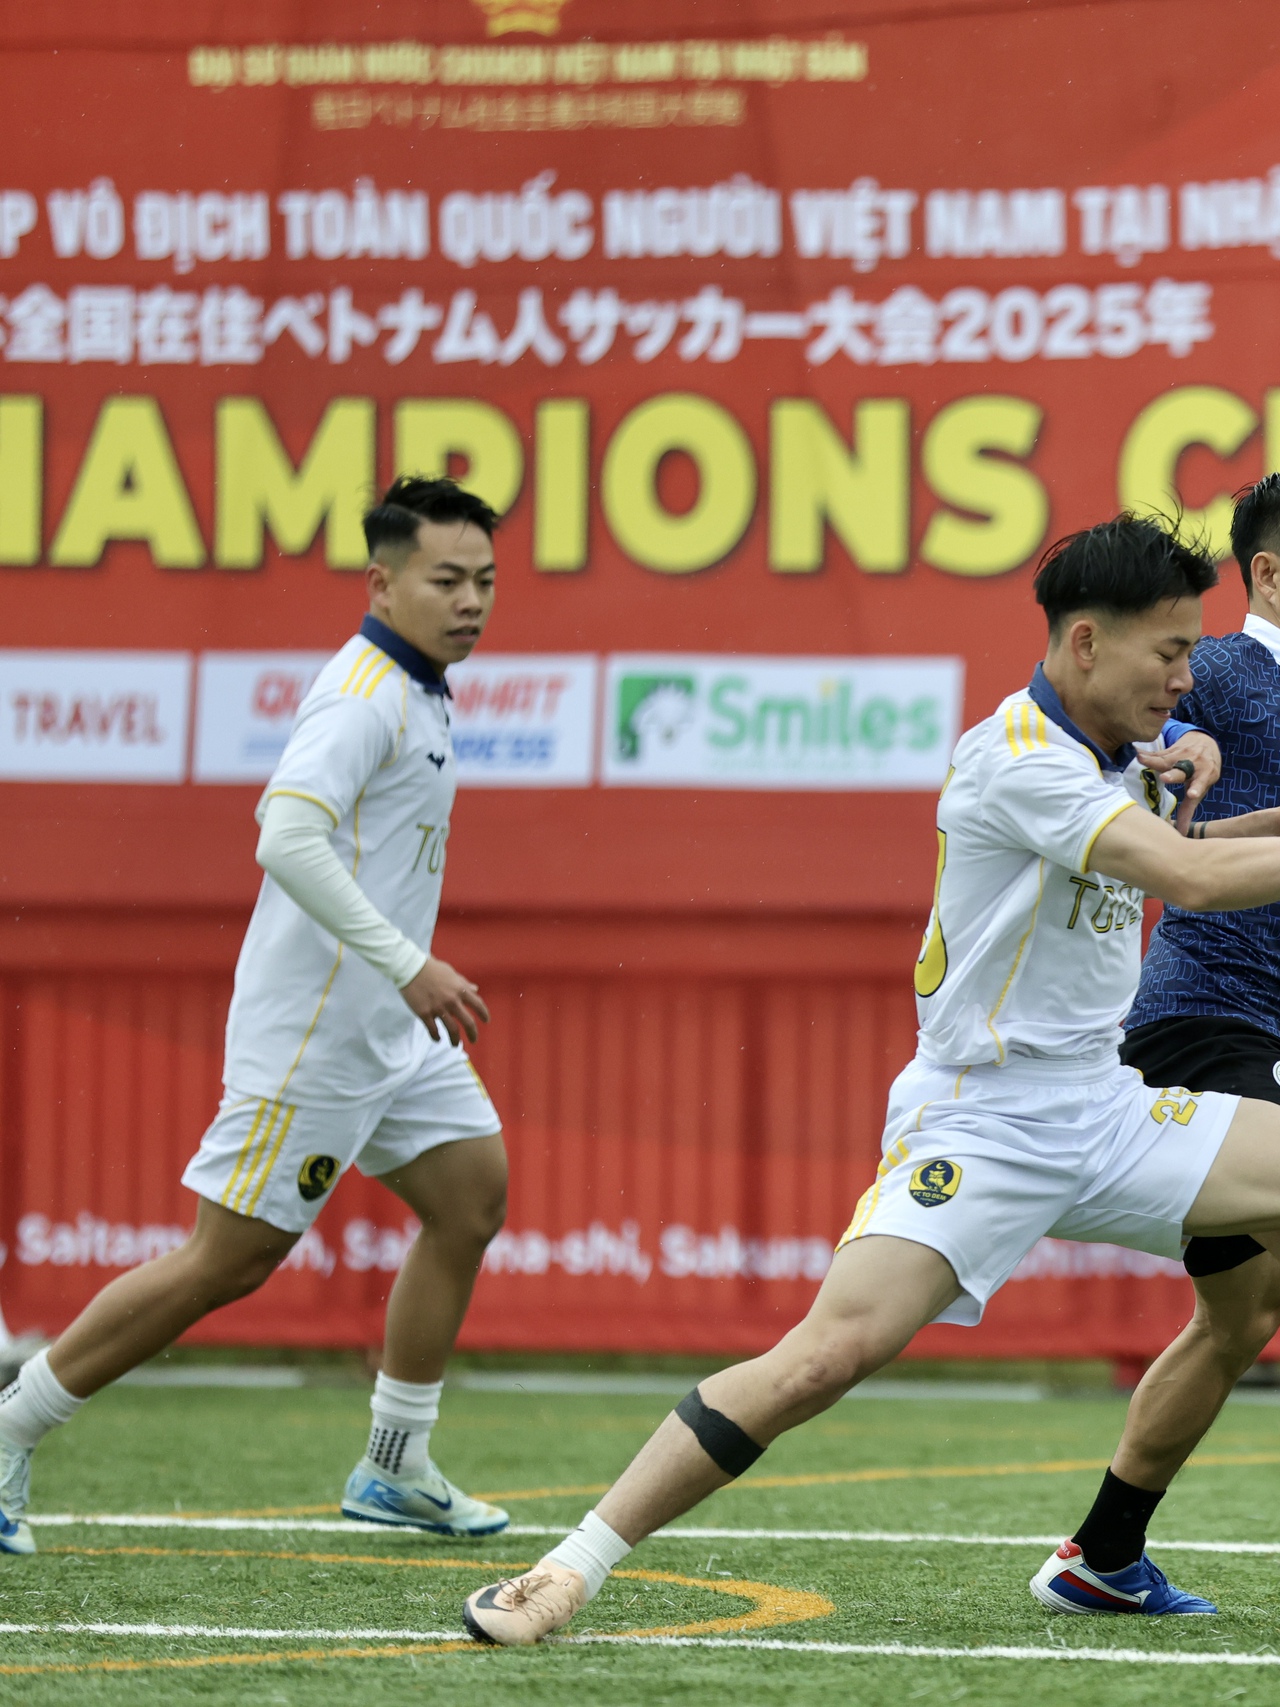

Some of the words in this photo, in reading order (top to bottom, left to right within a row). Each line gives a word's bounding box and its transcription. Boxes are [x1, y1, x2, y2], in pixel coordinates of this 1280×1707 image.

[46, 176, 126, 260] VÔ
[134, 189, 271, 275] ĐỊCH
[278, 175, 431, 261] TOÀN
[438, 168, 595, 267] QUỐC
[603, 174, 781, 259] NGƯỜI
[790, 176, 916, 273] VIỆT
[924, 188, 1067, 258] NAM
[1074, 184, 1172, 268] TẠI
[0, 282, 1213, 366] 全国在住ベトナム人サッカー大会2025年
[10, 687, 166, 747] TRAVEL
[705, 671, 942, 752] Smiles
